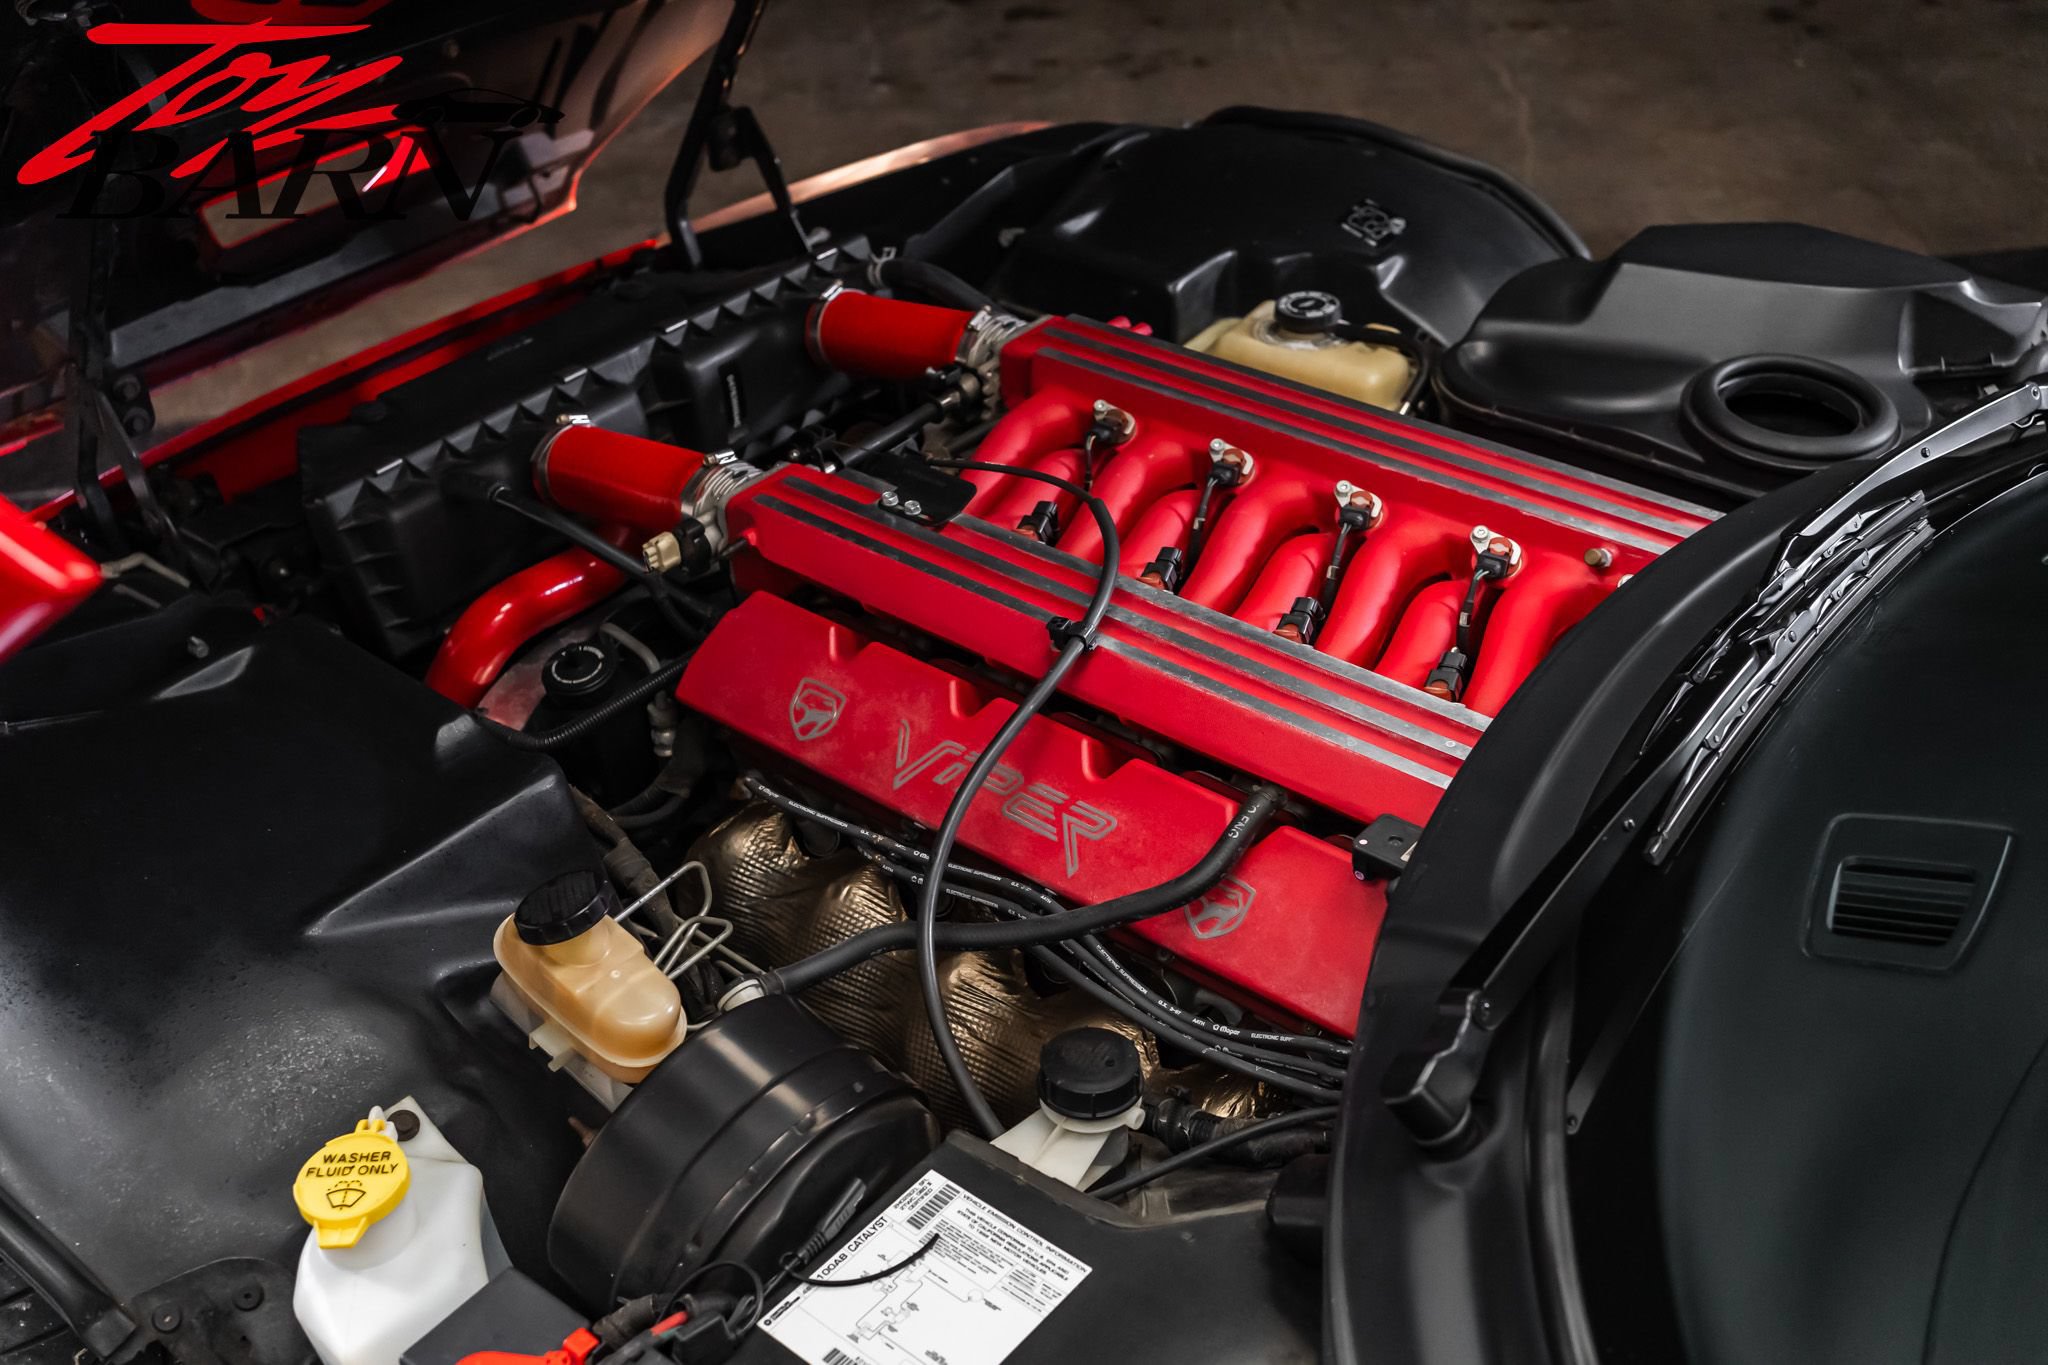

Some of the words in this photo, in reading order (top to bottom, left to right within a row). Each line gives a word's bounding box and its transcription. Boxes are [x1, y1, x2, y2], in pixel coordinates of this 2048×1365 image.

[1251, 1032, 1279, 1041] ELECTRONIC
[323, 1151, 391, 1164] WASHER
[306, 1165, 353, 1178] FLUID
[357, 1163, 399, 1176] ONLY
[847, 1216, 889, 1253] CATALYST
[963, 1194, 987, 1210] VEHICLE
[987, 1209, 1016, 1229] EMISSION
[1016, 1226, 1043, 1246] CONTROL
[1045, 1245, 1087, 1273] INFORMATION
